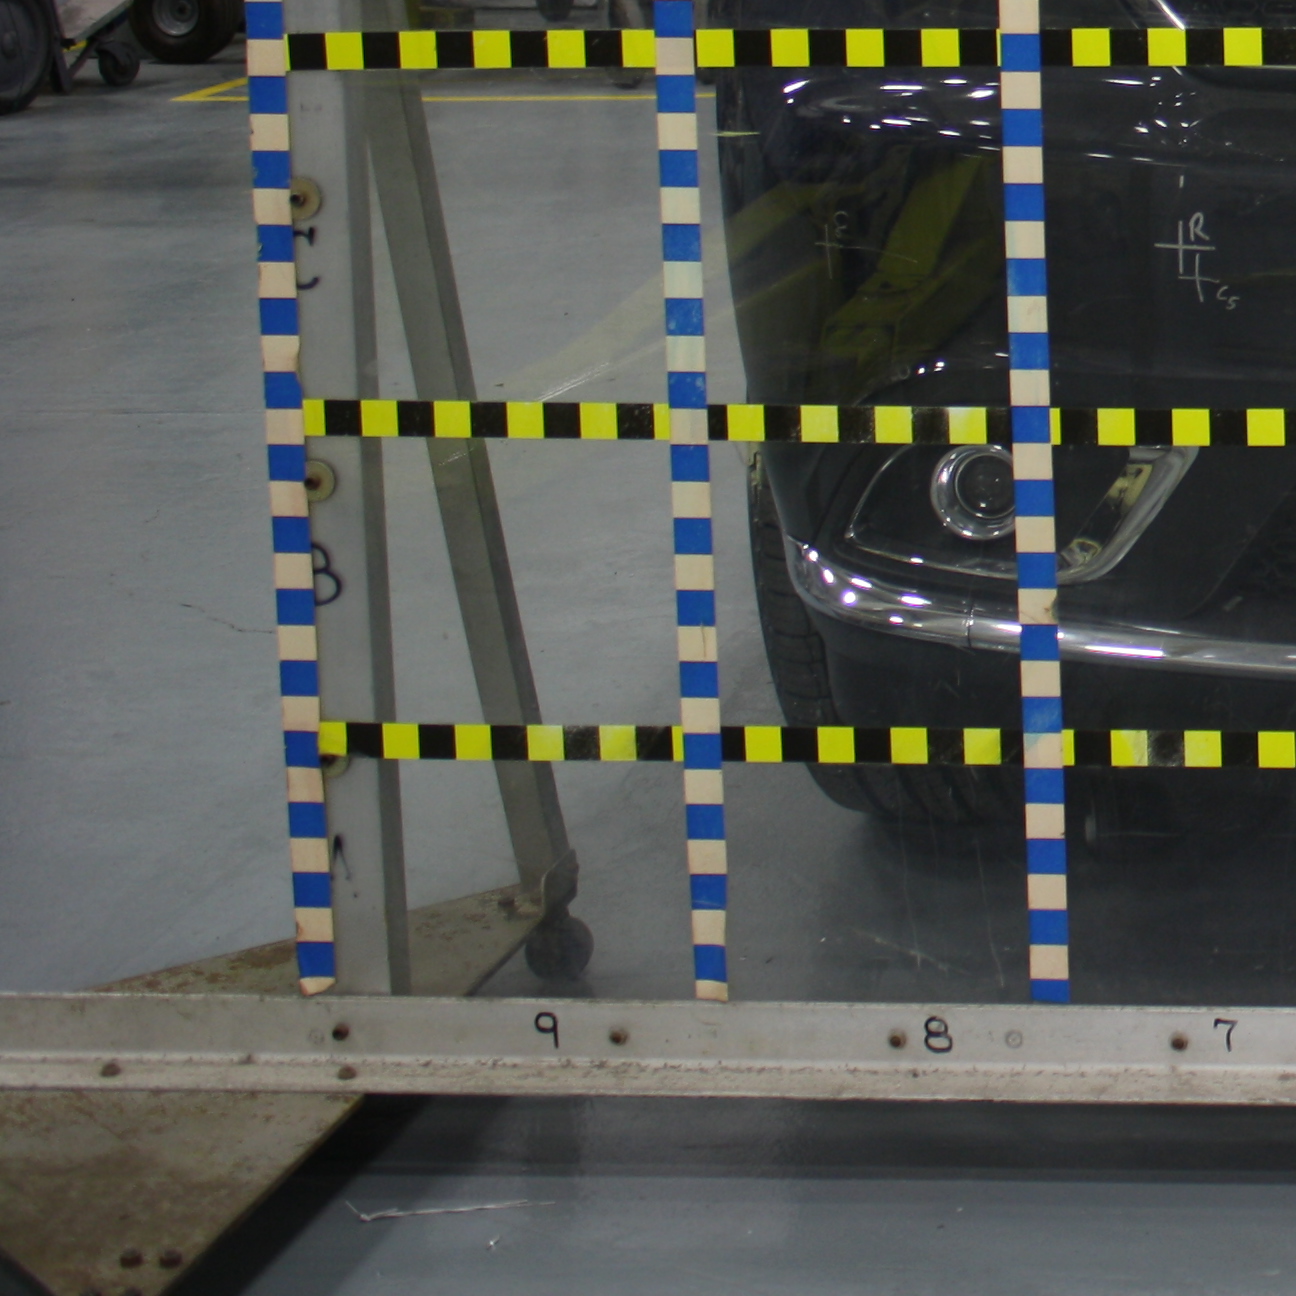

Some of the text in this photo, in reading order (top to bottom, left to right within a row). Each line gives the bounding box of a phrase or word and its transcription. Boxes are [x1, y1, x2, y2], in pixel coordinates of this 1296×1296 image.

[534, 1011, 559, 1049] 9
[923, 1015, 954, 1054] 8
[1212, 1017, 1238, 1053] 7
